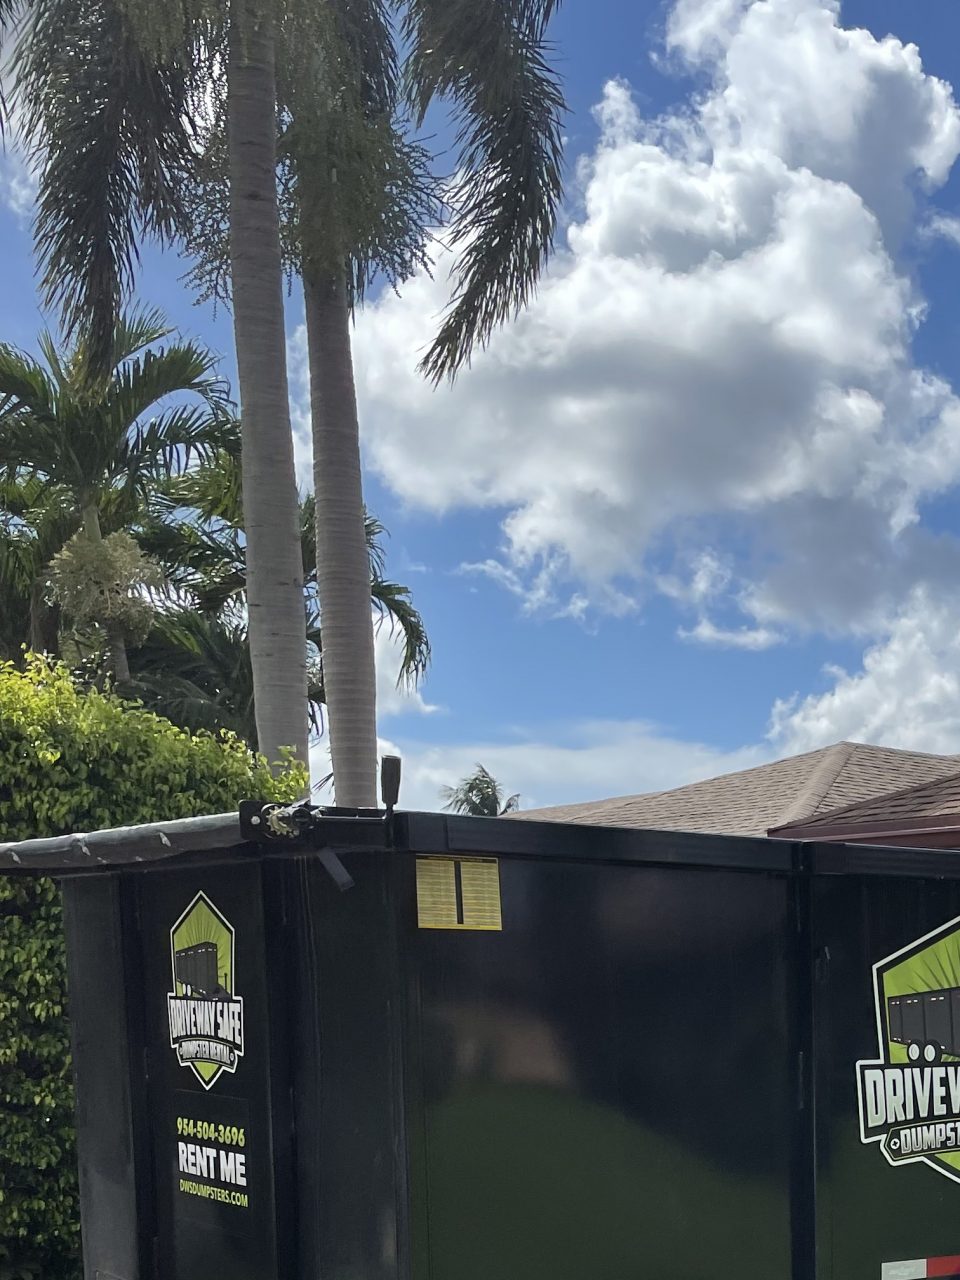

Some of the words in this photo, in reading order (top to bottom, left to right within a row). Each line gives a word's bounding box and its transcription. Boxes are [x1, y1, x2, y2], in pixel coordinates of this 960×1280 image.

[170, 1000, 216, 1038] DRIVEWAY
[217, 1003, 241, 1044] SAFE
[177, 1117, 245, 1147] 954-504-3696
[178, 1142, 217, 1179] RENT
[220, 1150, 247, 1186] ME
[180, 1179, 248, 1207] DWSDUMPSTERS.COM
